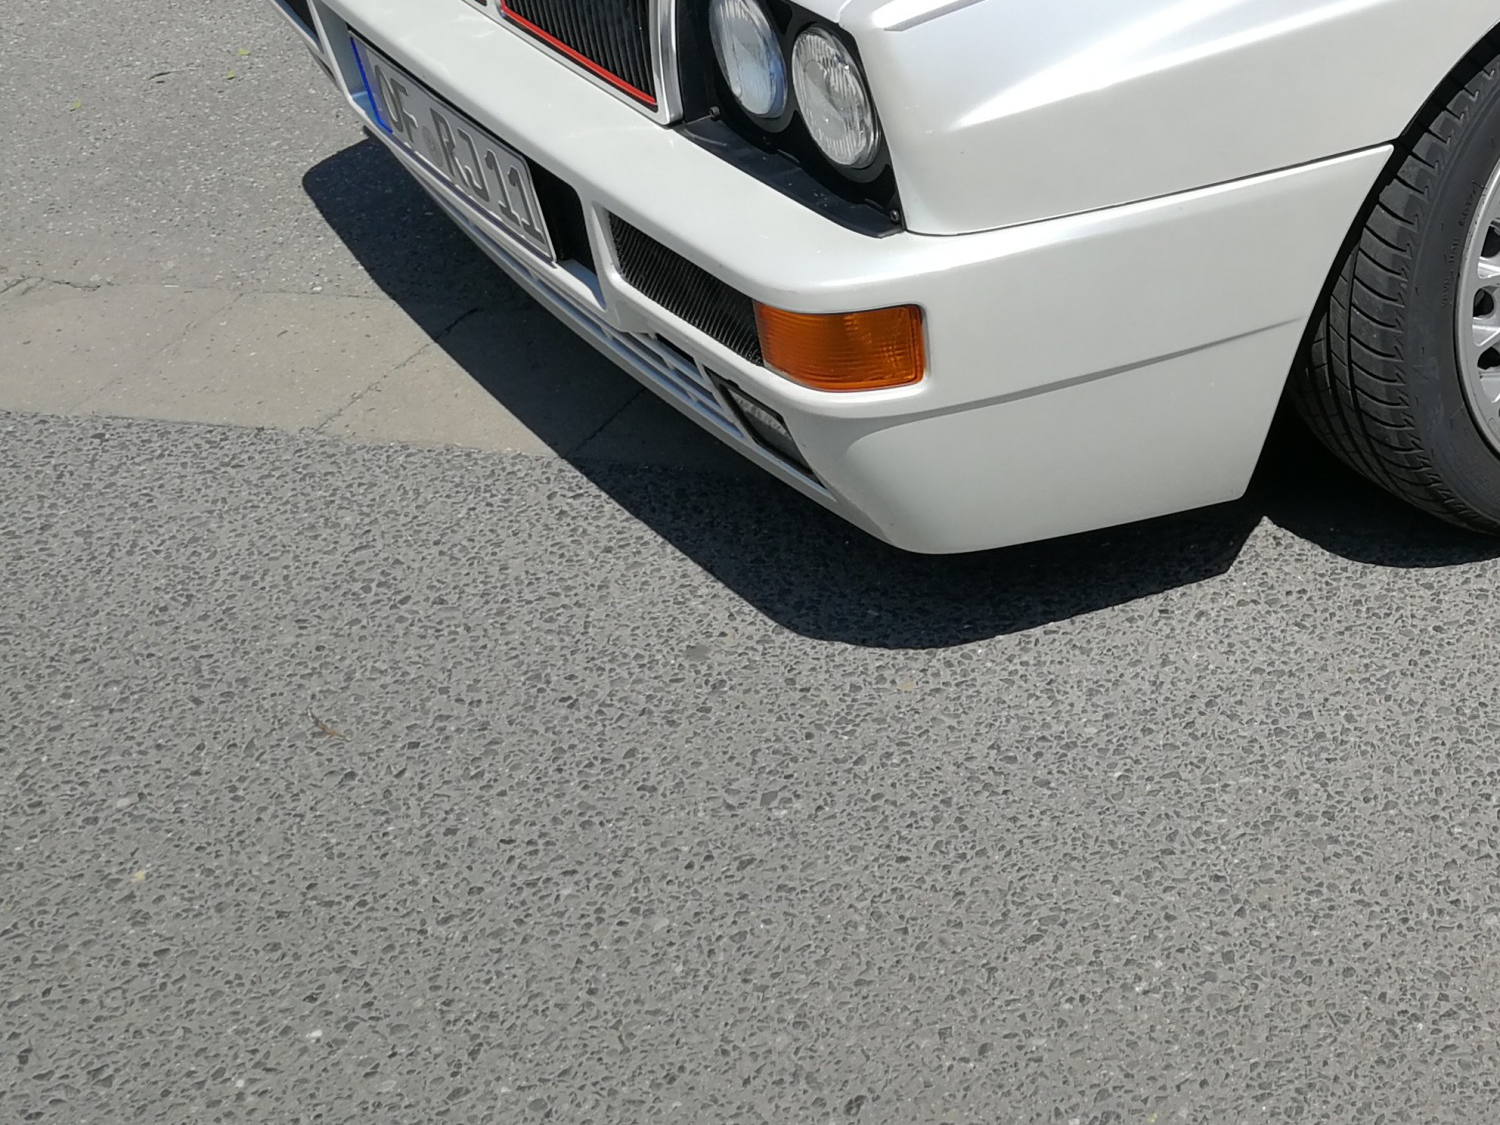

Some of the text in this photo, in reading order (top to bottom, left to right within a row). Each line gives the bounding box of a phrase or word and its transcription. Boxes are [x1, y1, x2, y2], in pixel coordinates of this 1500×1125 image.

[376, 65, 547, 245] OF RJ 11
